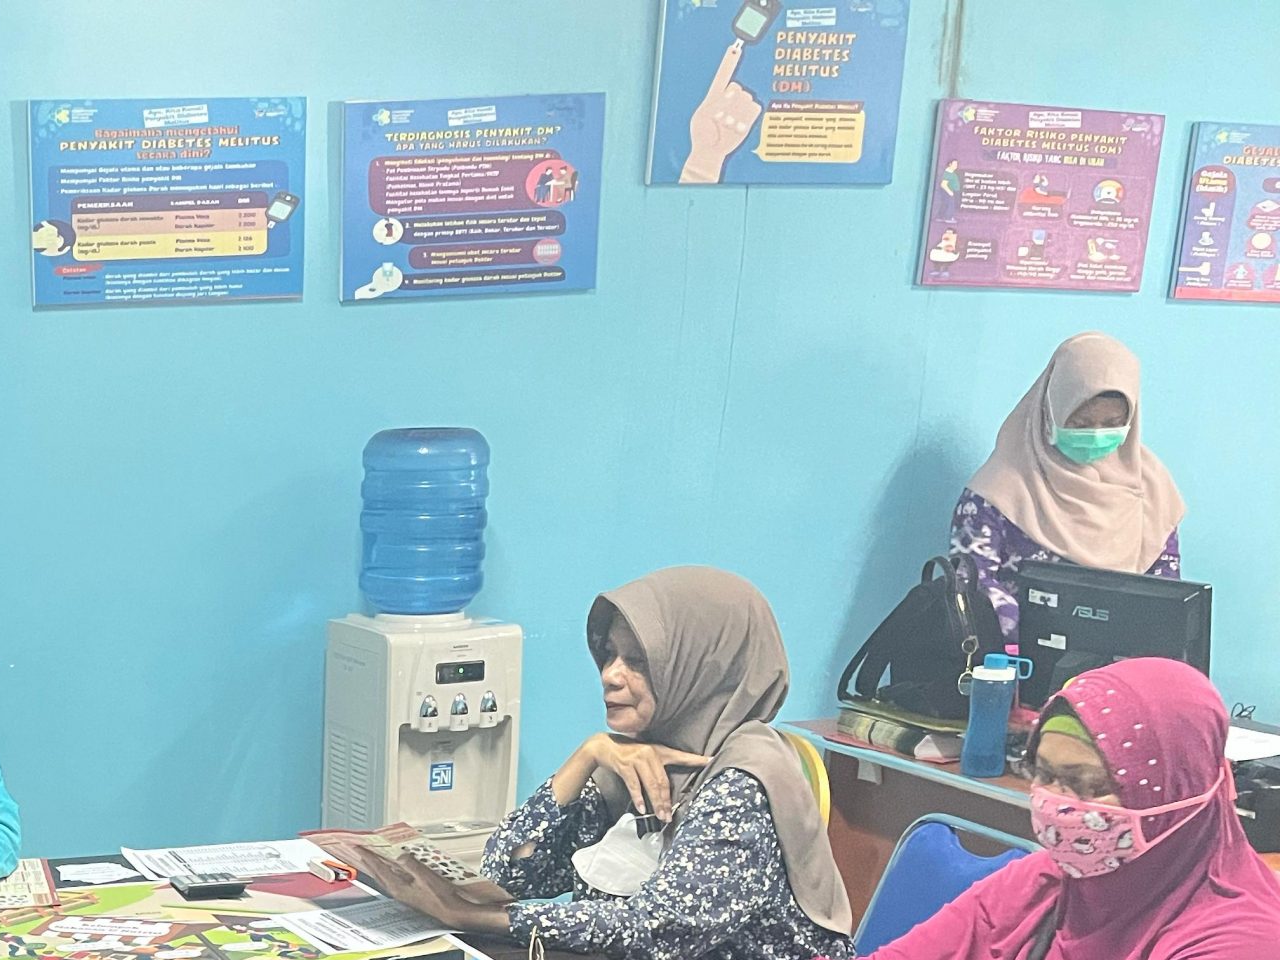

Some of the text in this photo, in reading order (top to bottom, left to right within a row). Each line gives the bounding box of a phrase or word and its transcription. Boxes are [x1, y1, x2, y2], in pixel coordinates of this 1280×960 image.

[776, 31, 857, 45] PENYAKIT
[774, 47, 850, 62] DIABETES
[772, 63, 840, 78] MELITUS
[772, 80, 811, 93] (DM)
[95, 126, 240, 139] Bagaimana mengetahui
[385, 126, 561, 142] TERDIAGNOSIS PENYAKIT DM?
[973, 126, 1128, 145] FAKTOR RISIKO PENYAKIT
[59, 136, 281, 151] PENYAKIT DIABETES MELITUS
[396, 137, 548, 151] APA YANG HARUS DILAKUKAN?
[981, 137, 1122, 154] DIABETES MELITUS (DM)
[1243, 145, 1280, 157] GEJAL
[180, 149, 212, 159] dini?
[997, 151, 1021, 162] FAKTOR
[1072, 605, 1110, 622] ASUS
[431, 770, 452, 785] SNI
